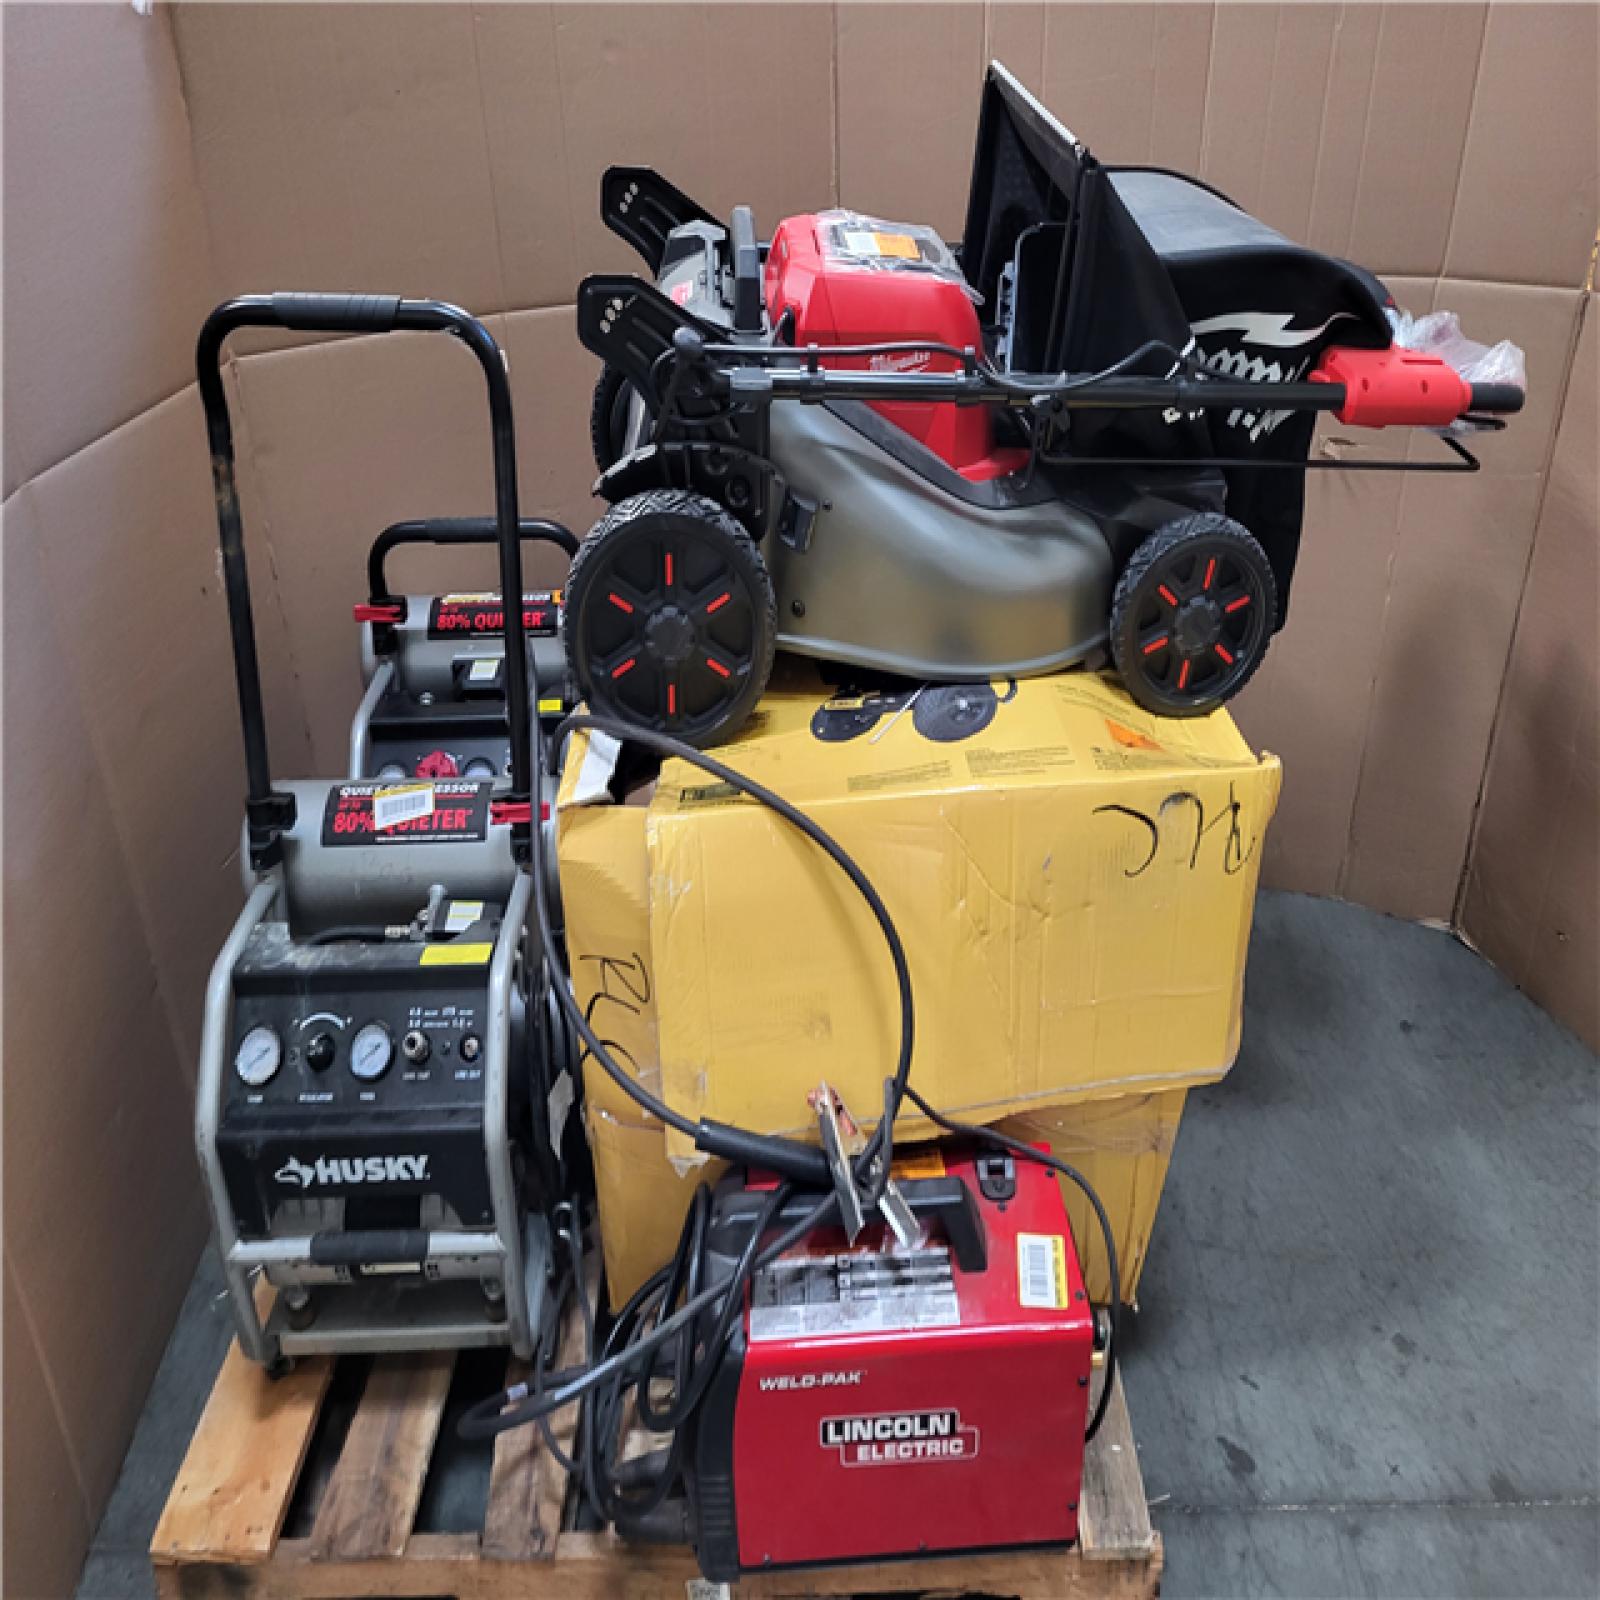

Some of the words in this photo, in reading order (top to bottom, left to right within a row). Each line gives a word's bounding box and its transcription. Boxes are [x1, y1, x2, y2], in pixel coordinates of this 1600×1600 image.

[315, 1153, 430, 1185] HUSKY
[759, 1371, 861, 1391] WELD-PAK
[828, 1414, 951, 1443] LINCOLN
[856, 1439, 965, 1461] ELECTRIC
